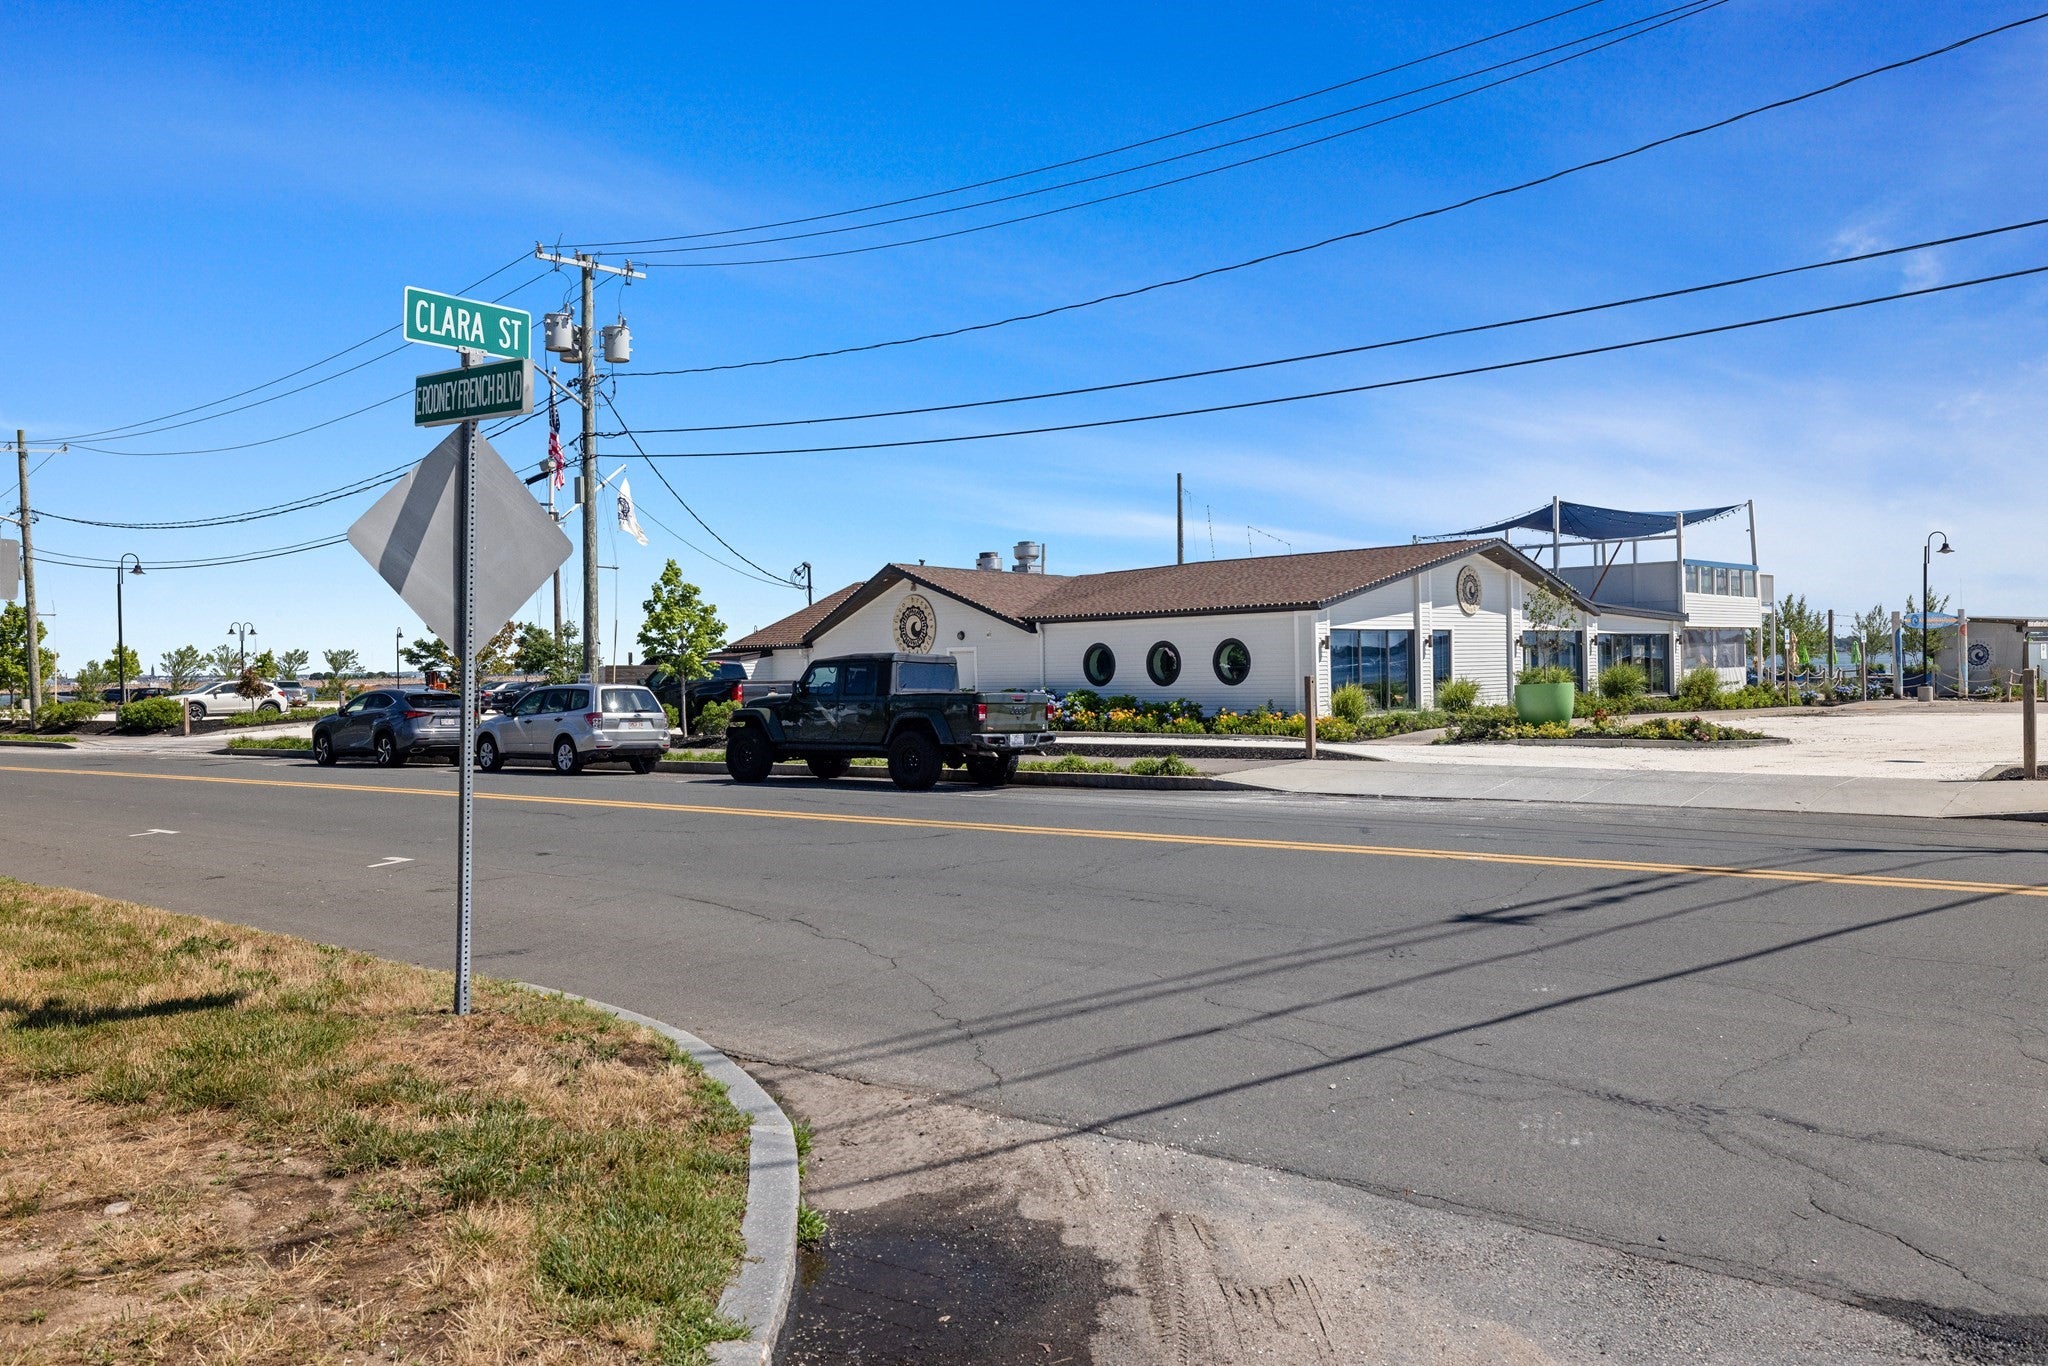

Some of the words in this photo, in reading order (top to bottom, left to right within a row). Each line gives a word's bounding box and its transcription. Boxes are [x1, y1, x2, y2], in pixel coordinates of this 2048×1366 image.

[415, 299, 485, 344] CLARA
[498, 317, 522, 350] ST
[415, 387, 423, 416] E
[422, 380, 458, 415] RODNEY
[457, 374, 495, 411] FRENCH
[496, 370, 522, 404] BLVD
